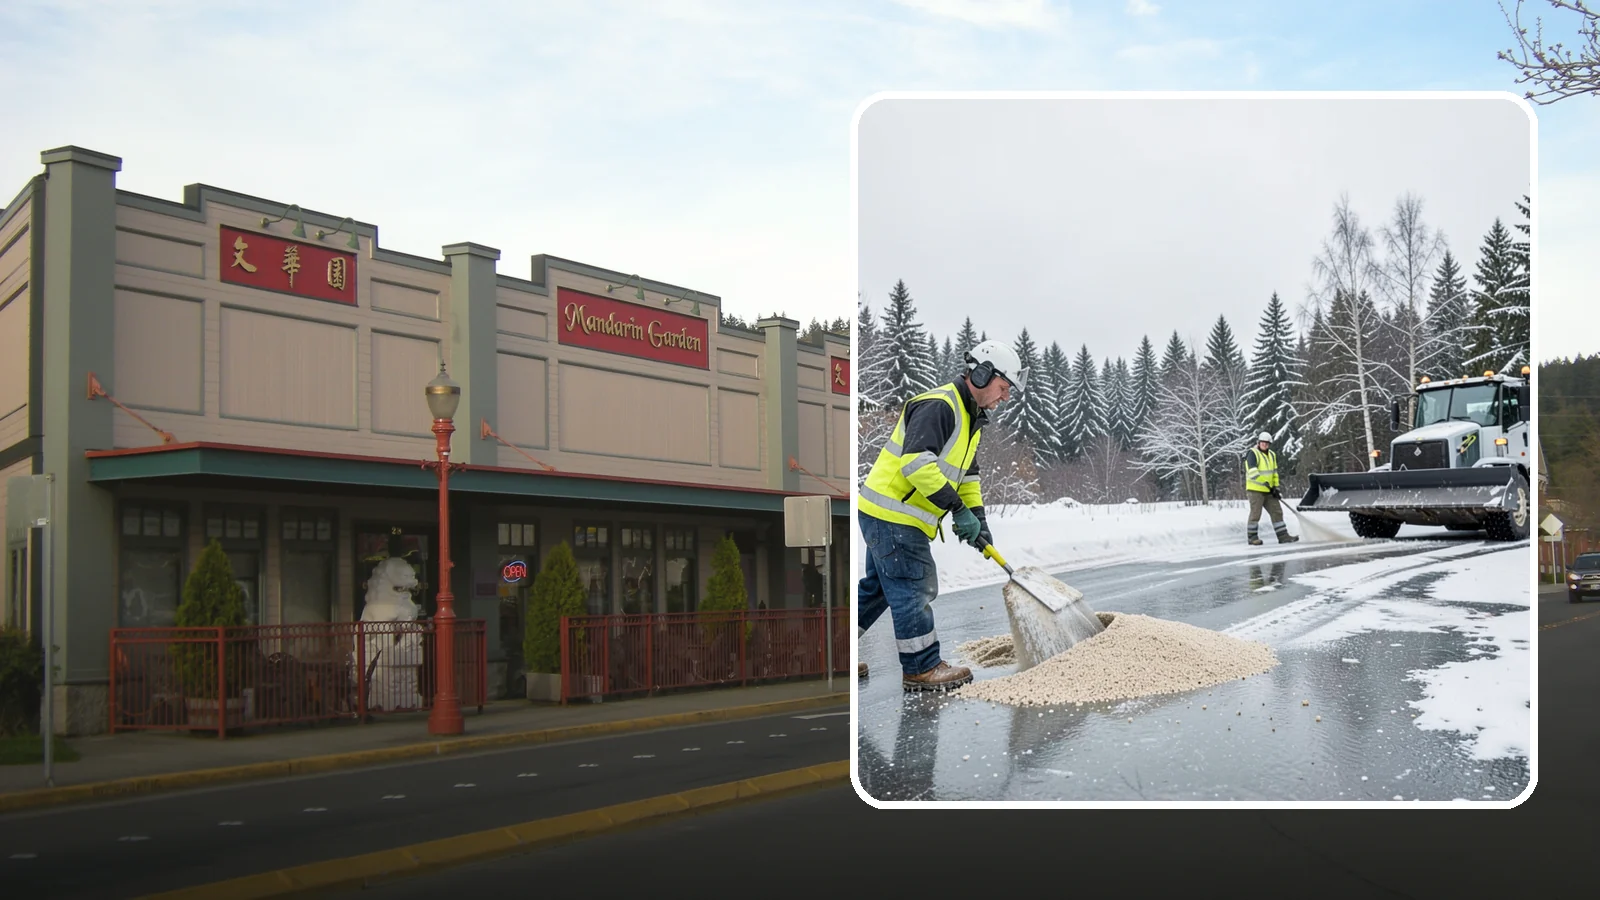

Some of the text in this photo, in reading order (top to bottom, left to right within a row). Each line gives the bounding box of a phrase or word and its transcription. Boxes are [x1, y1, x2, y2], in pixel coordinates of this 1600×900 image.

[231, 236, 346, 290] 文華園
[564, 302, 701, 352] Mandarin Garden
[503, 565, 527, 578] OPEN
